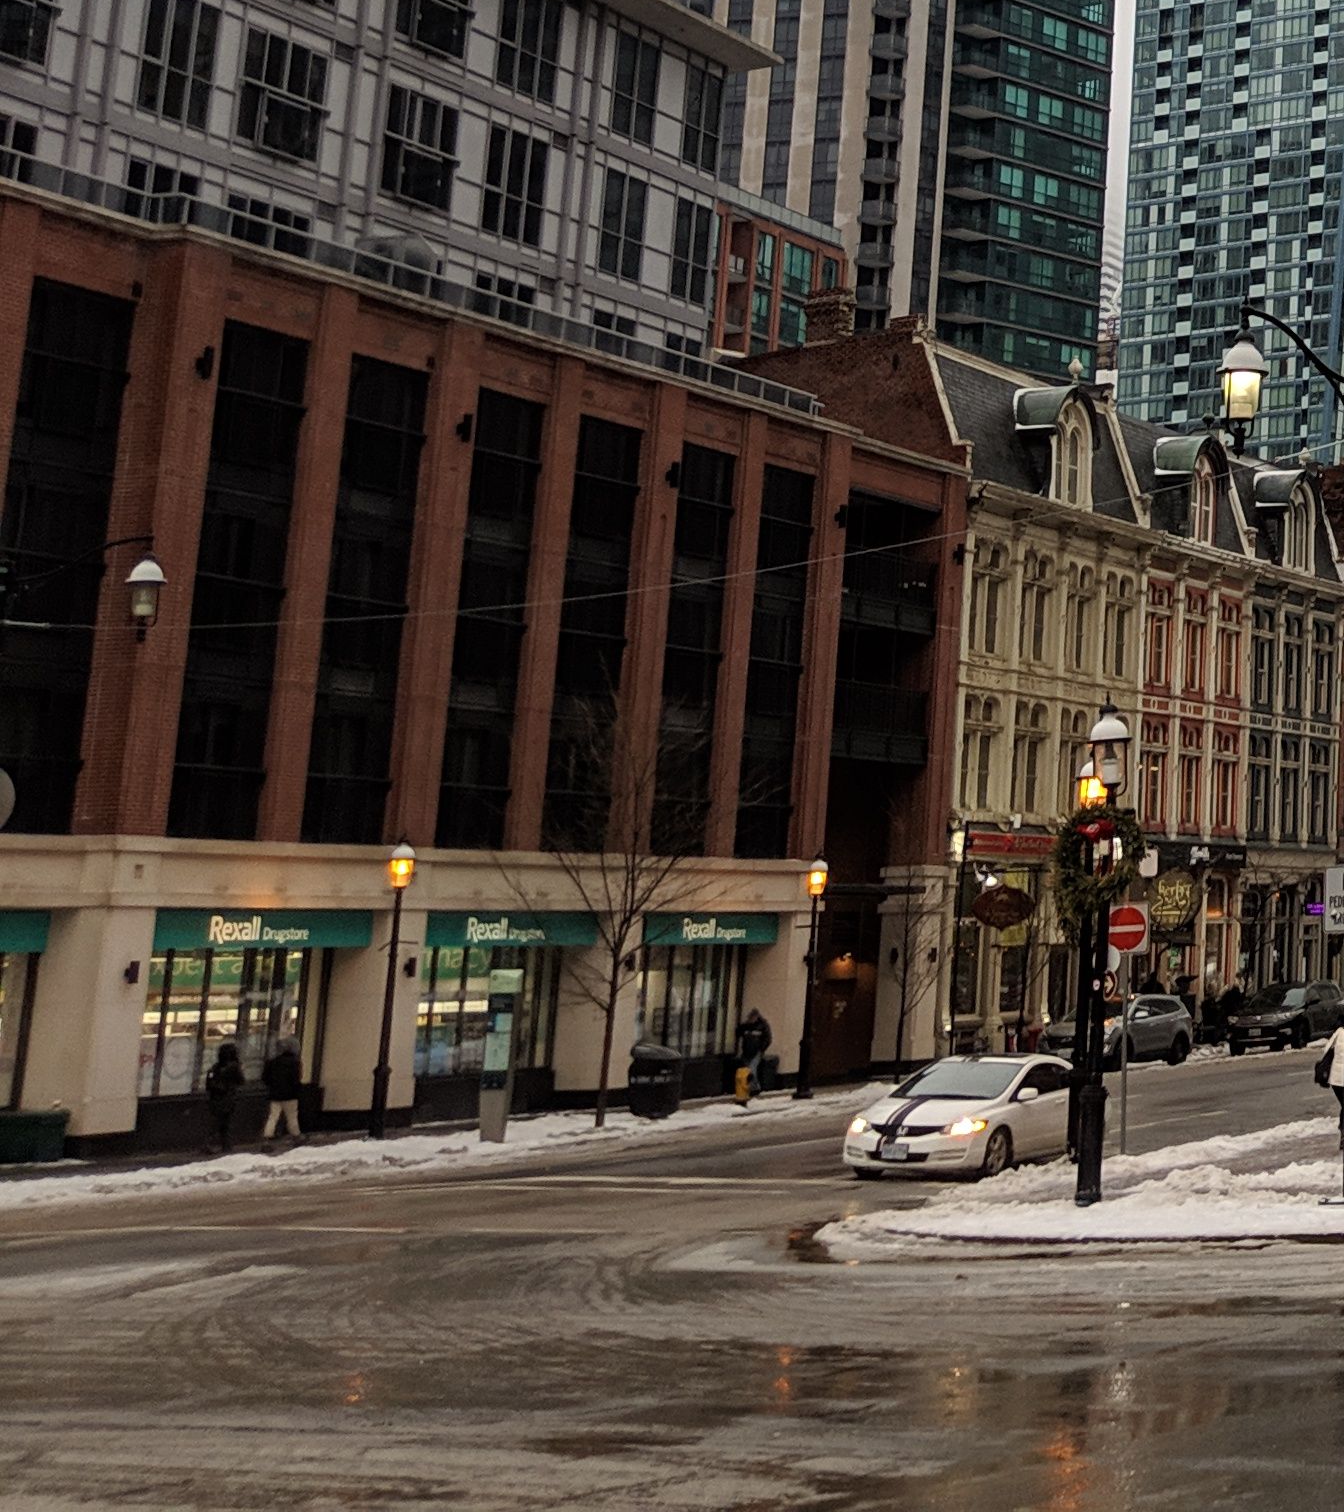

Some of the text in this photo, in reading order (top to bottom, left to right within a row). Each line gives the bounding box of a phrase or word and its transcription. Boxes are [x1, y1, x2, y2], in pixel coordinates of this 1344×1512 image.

[208, 915, 310, 944] Rexall Drugstore
[467, 917, 508, 943] Rexall
[683, 917, 716, 940] Rexall
